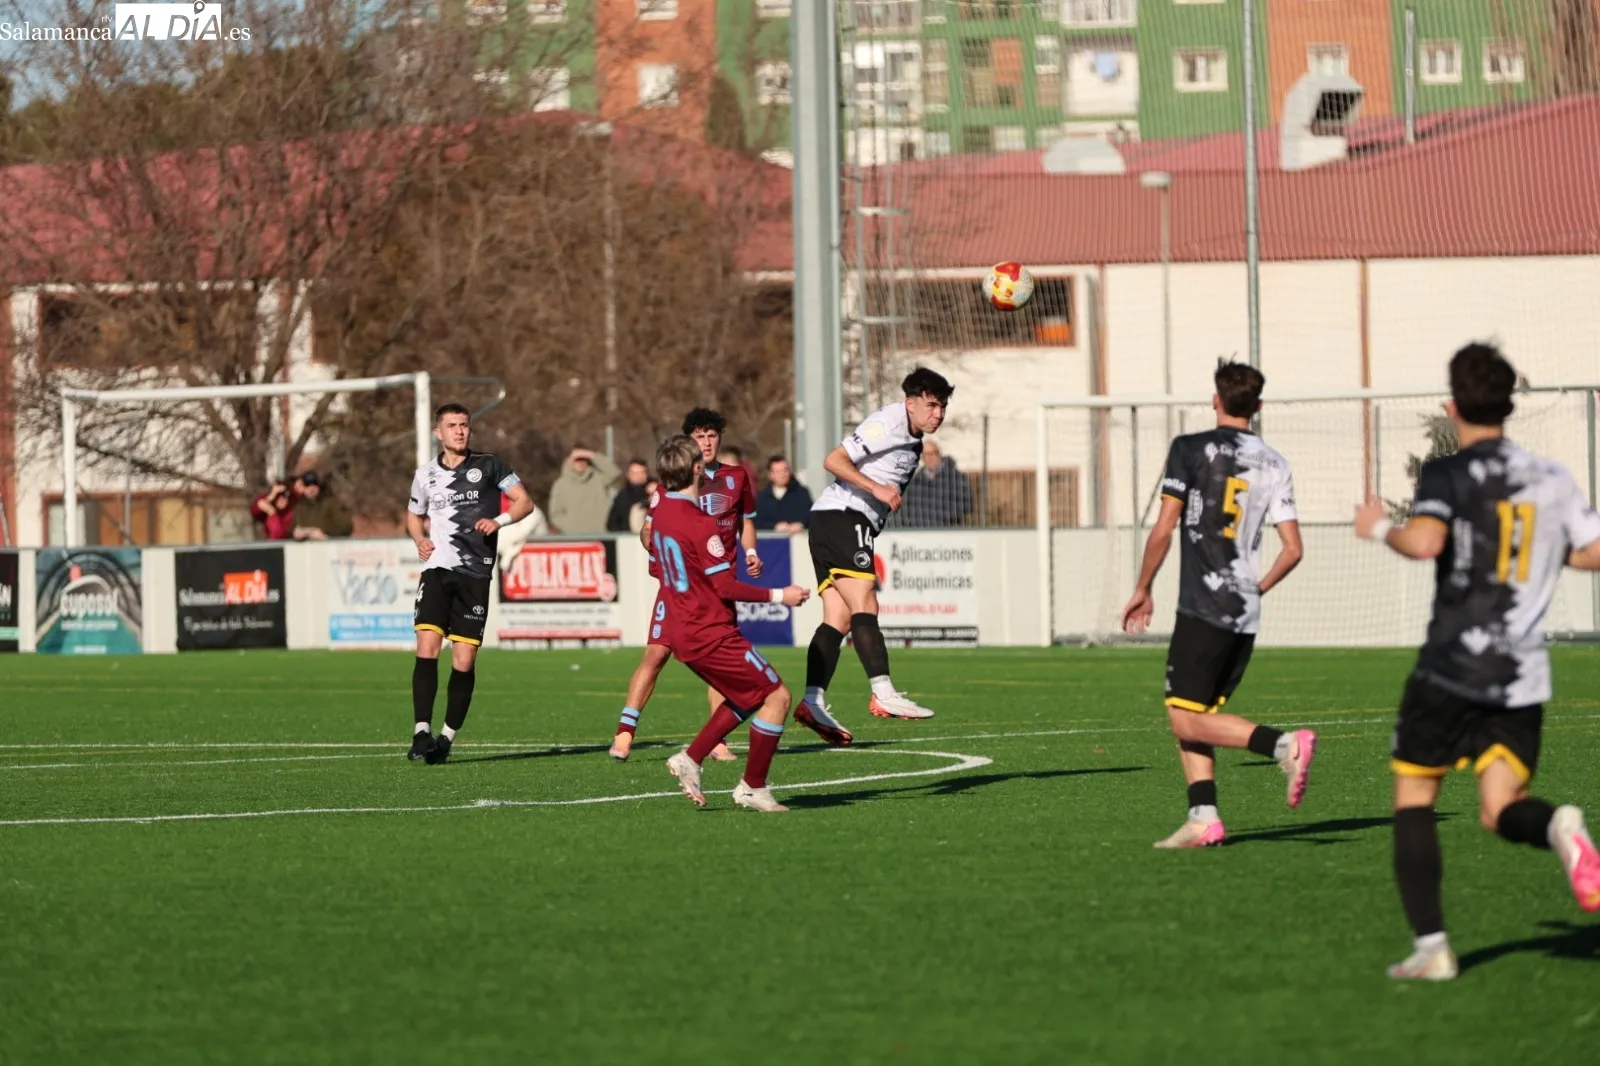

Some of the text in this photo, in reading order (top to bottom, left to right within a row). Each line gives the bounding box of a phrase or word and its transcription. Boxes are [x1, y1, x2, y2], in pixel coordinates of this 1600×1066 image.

[448, 493, 465, 503] Don
[466, 490, 479, 500] QR
[1222, 476, 1249, 540] 5
[855, 524, 873, 550] 14
[654, 531, 689, 592] 10
[890, 541, 974, 567] Aplicaciones
[416, 582, 425, 602] 4
[655, 601, 665, 621] 9
